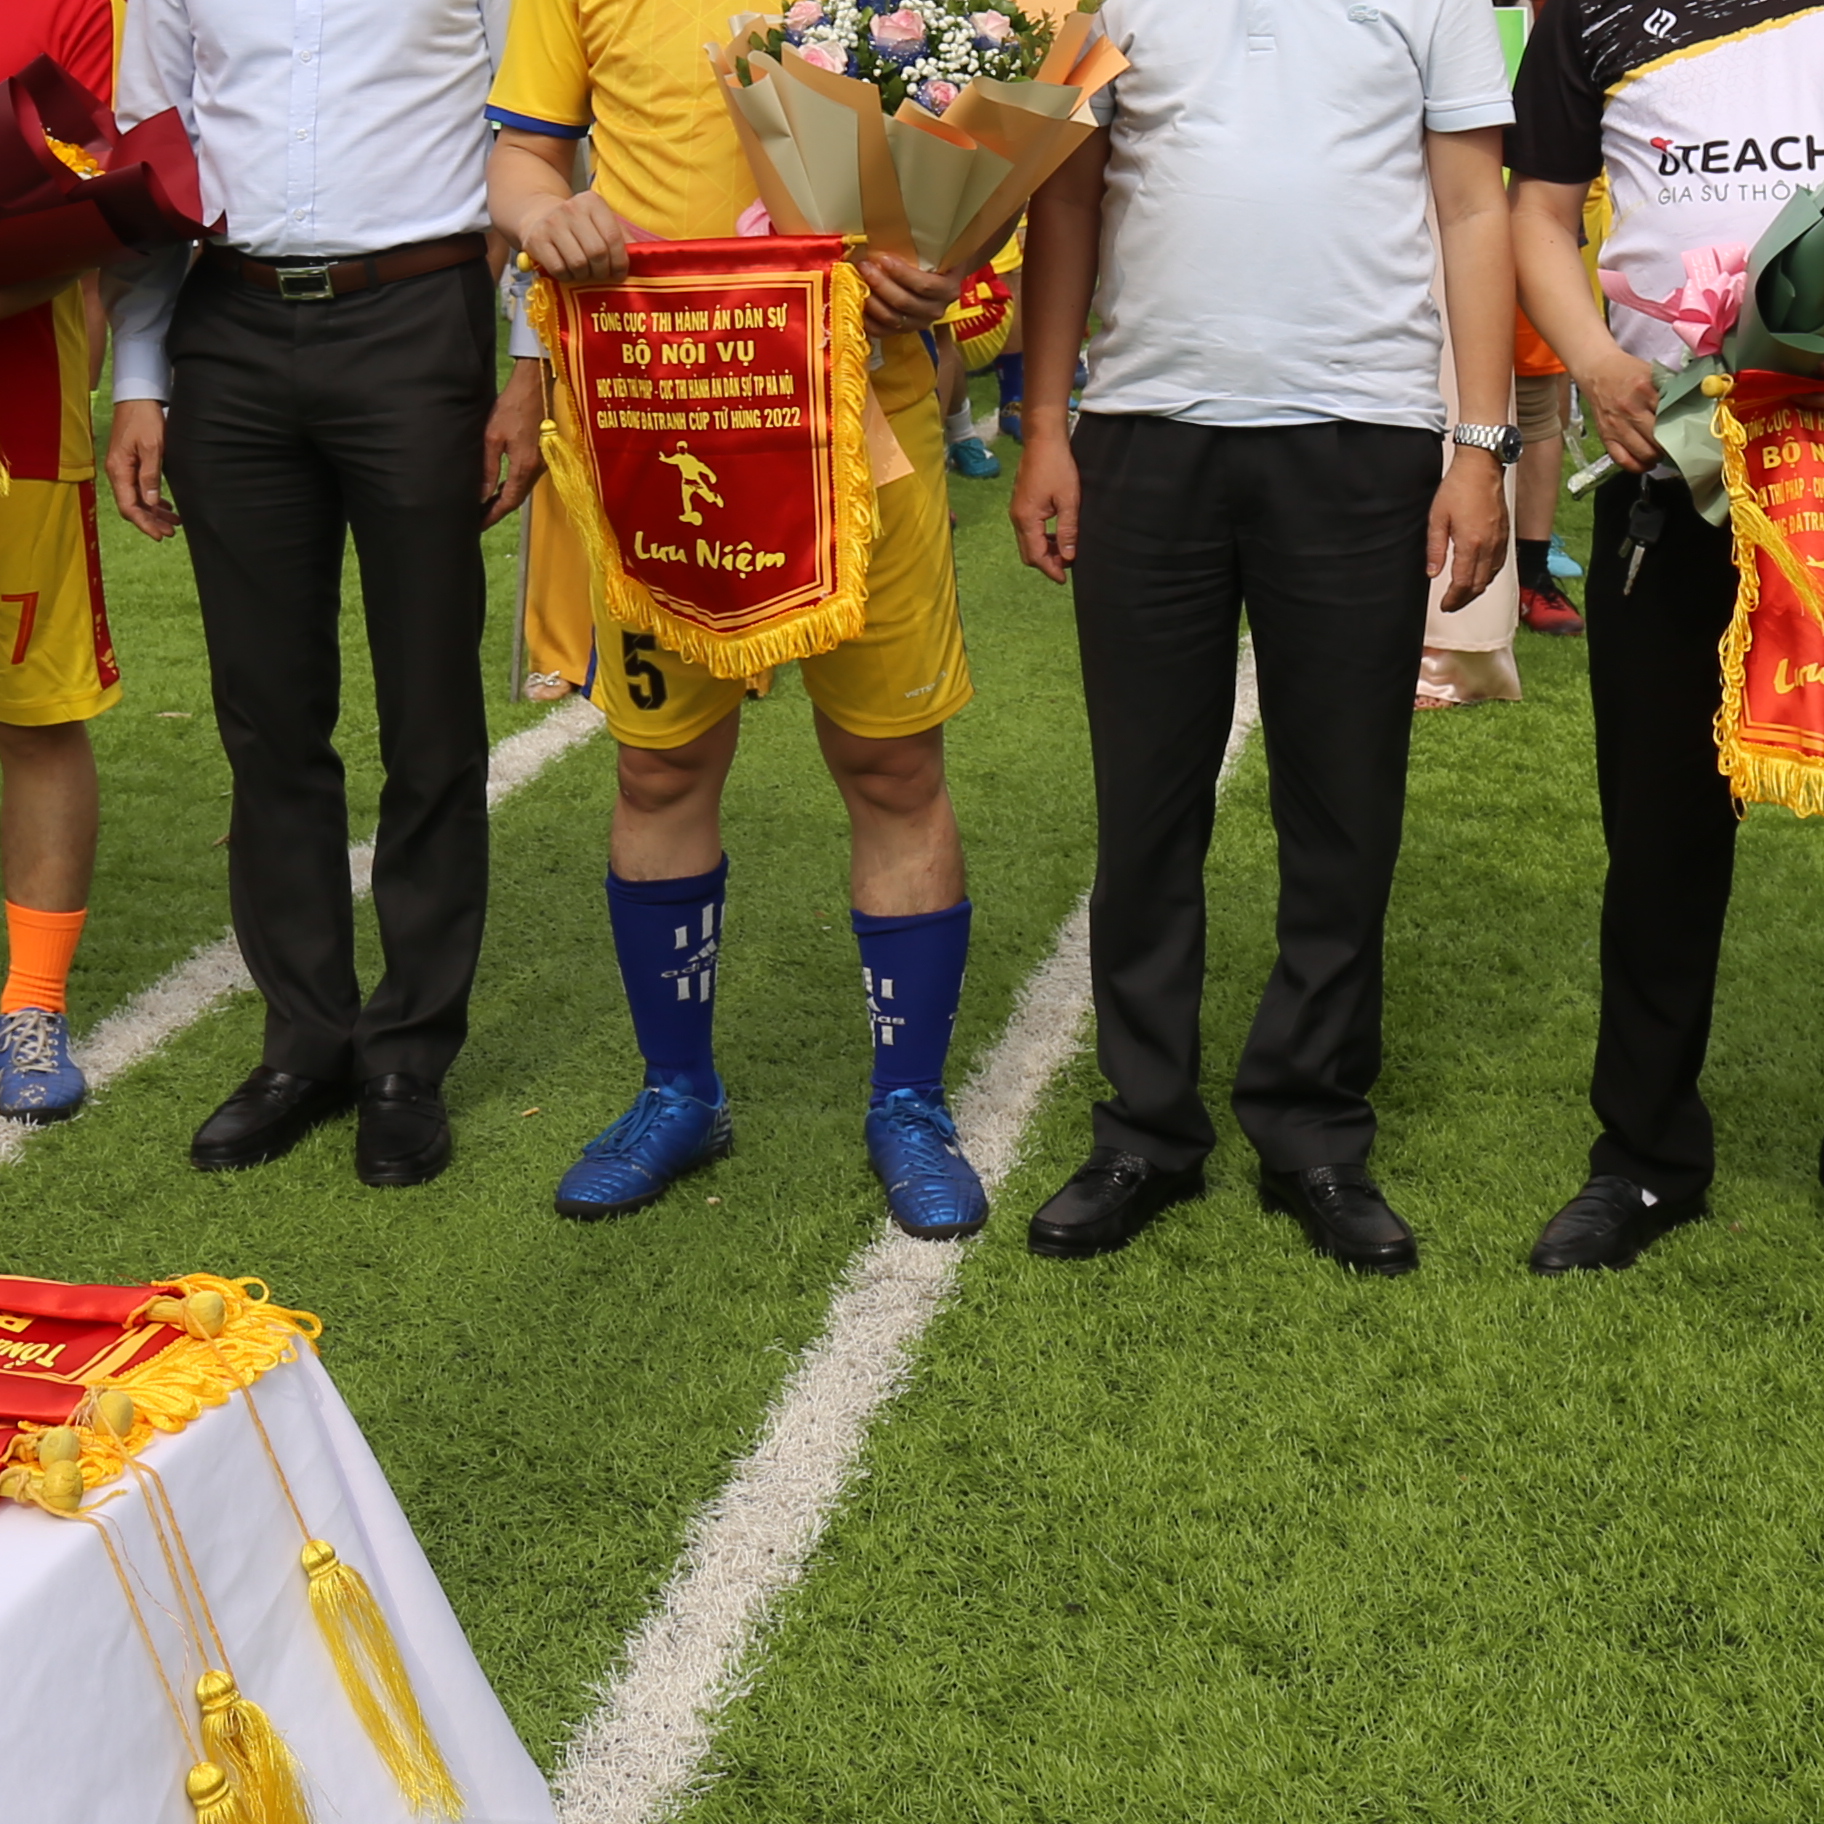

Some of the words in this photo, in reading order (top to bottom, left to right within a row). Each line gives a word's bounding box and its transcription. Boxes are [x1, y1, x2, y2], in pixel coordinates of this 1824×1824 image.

[1658, 186, 1693, 205] GIA
[1701, 182, 1729, 202] SƯ
[591, 302, 622, 332] TỔNG
[623, 312, 647, 337] CỤC
[651, 312, 672, 332] THI
[675, 305, 709, 332] HÀNH
[712, 304, 731, 331] ÁN
[734, 302, 764, 329] DÂN
[767, 302, 788, 332] SỰ
[622, 338, 651, 370] BỘ
[662, 337, 706, 369] NỘI
[716, 340, 755, 367] VỤ
[597, 403, 619, 429] GIẢI
[689, 406, 710, 431] CÚP
[730, 405, 762, 429] HÙNG
[763, 407, 801, 428] 2022
[1762, 436, 1801, 469] BỘ
[634, 530, 688, 564] Lưu
[696, 538, 786, 578] Niệm
[1, 592, 39, 664] 7
[621, 632, 667, 710] 5
